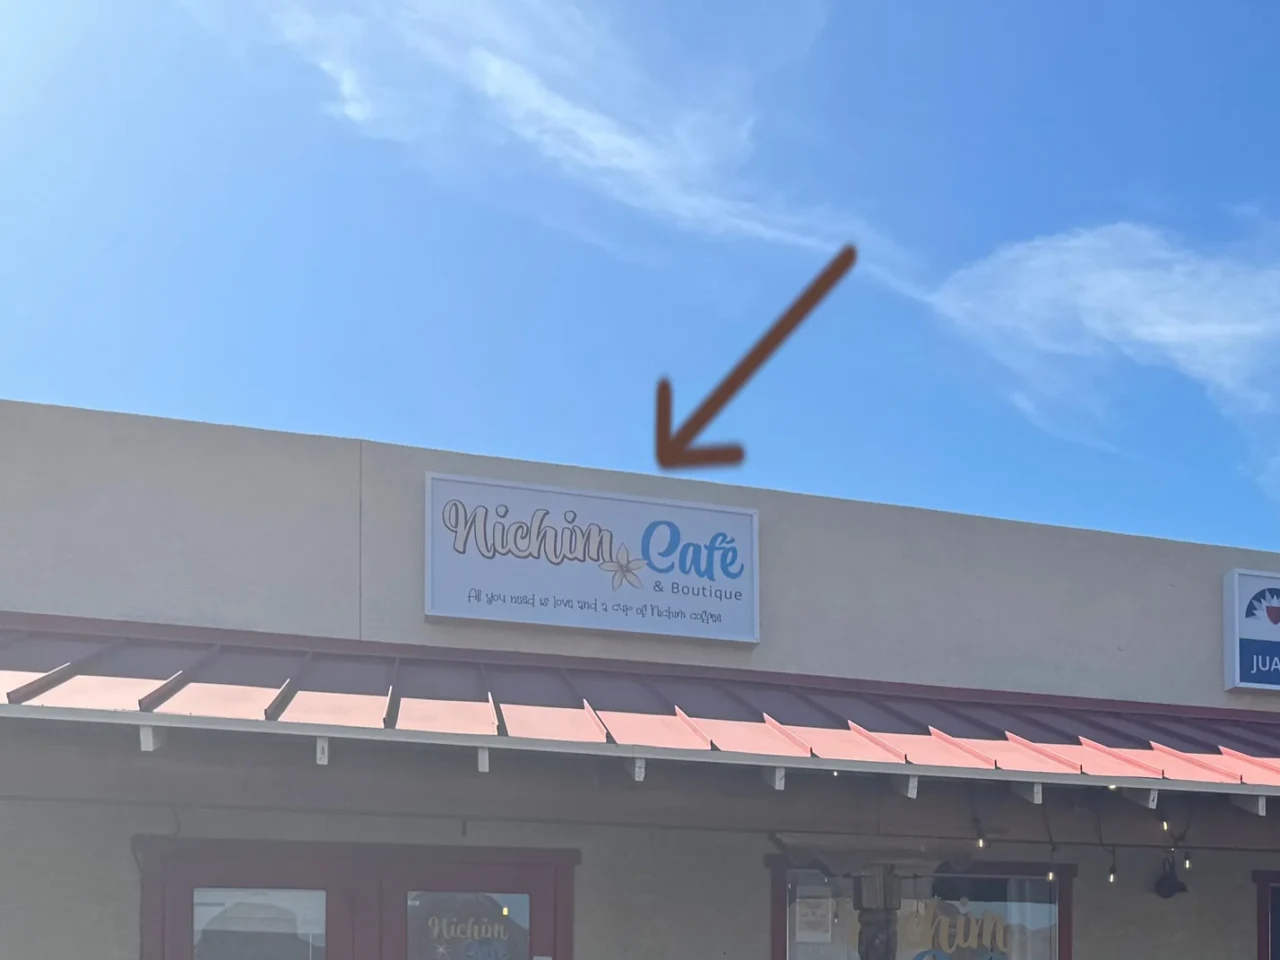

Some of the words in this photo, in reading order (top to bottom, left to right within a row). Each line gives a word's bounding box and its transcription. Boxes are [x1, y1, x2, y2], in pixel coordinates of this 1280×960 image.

[442, 499, 614, 566] Nichim
[640, 520, 745, 581] Café
[467, 589, 482, 604] All
[485, 593, 506, 606] you
[509, 594, 535, 607] need
[539, 597, 549, 607] is
[553, 596, 574, 609] love
[577, 599, 598, 612] and
[601, 602, 608, 612] a
[612, 602, 633, 616] cup
[636, 604, 648, 618] of
[650, 602, 686, 619] Nichim
[689, 610, 722, 624] coffee
[653, 580, 664, 592] &
[671, 581, 743, 601] Boutique
[428, 916, 509, 940] Nichim
[906, 898, 1012, 953] chim
